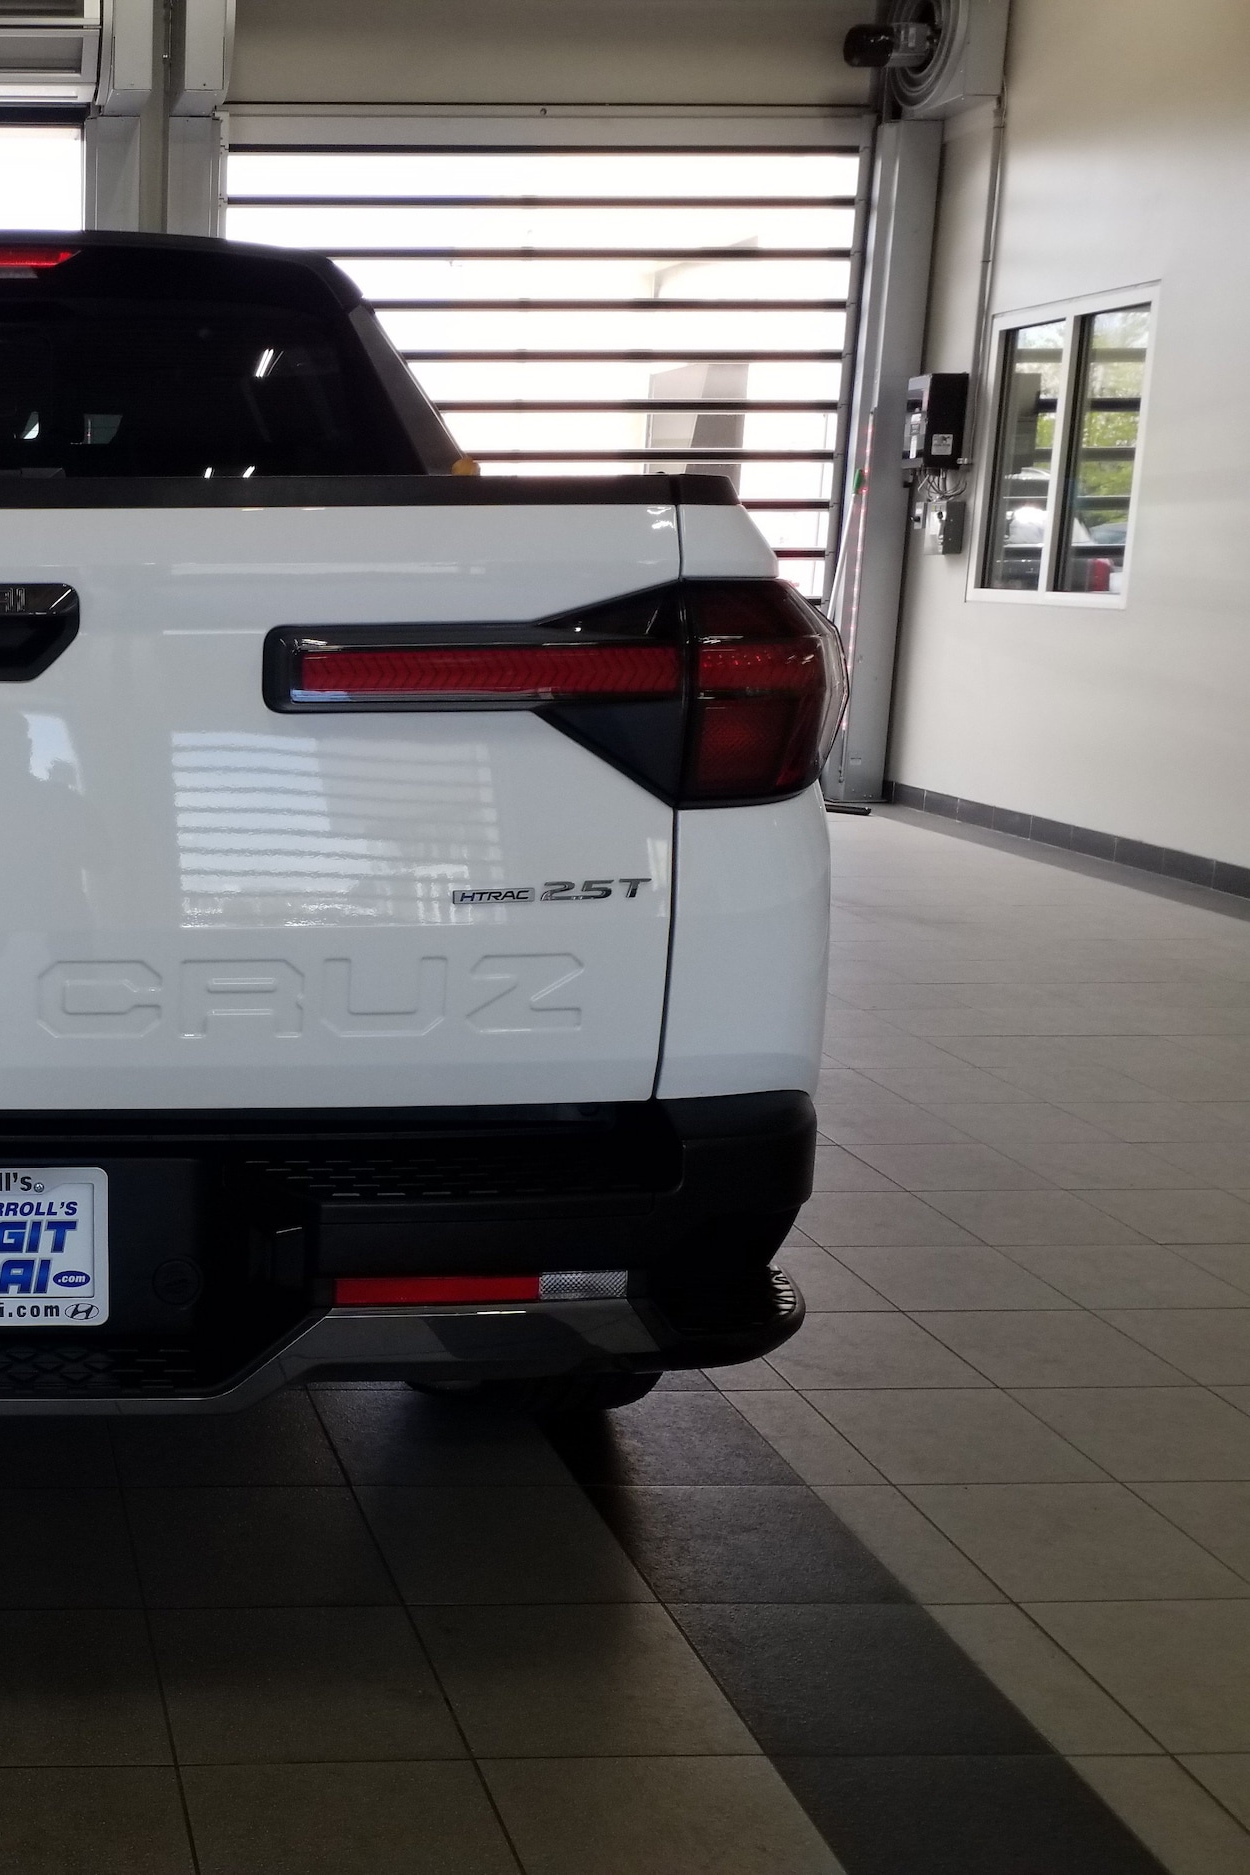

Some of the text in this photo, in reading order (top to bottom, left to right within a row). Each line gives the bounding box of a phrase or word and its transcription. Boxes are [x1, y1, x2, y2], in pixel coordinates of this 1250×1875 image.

[460, 890, 530, 902] HTRAC
[37, 952, 586, 1039] CRUZ
[57, 1275, 86, 1284] .com
